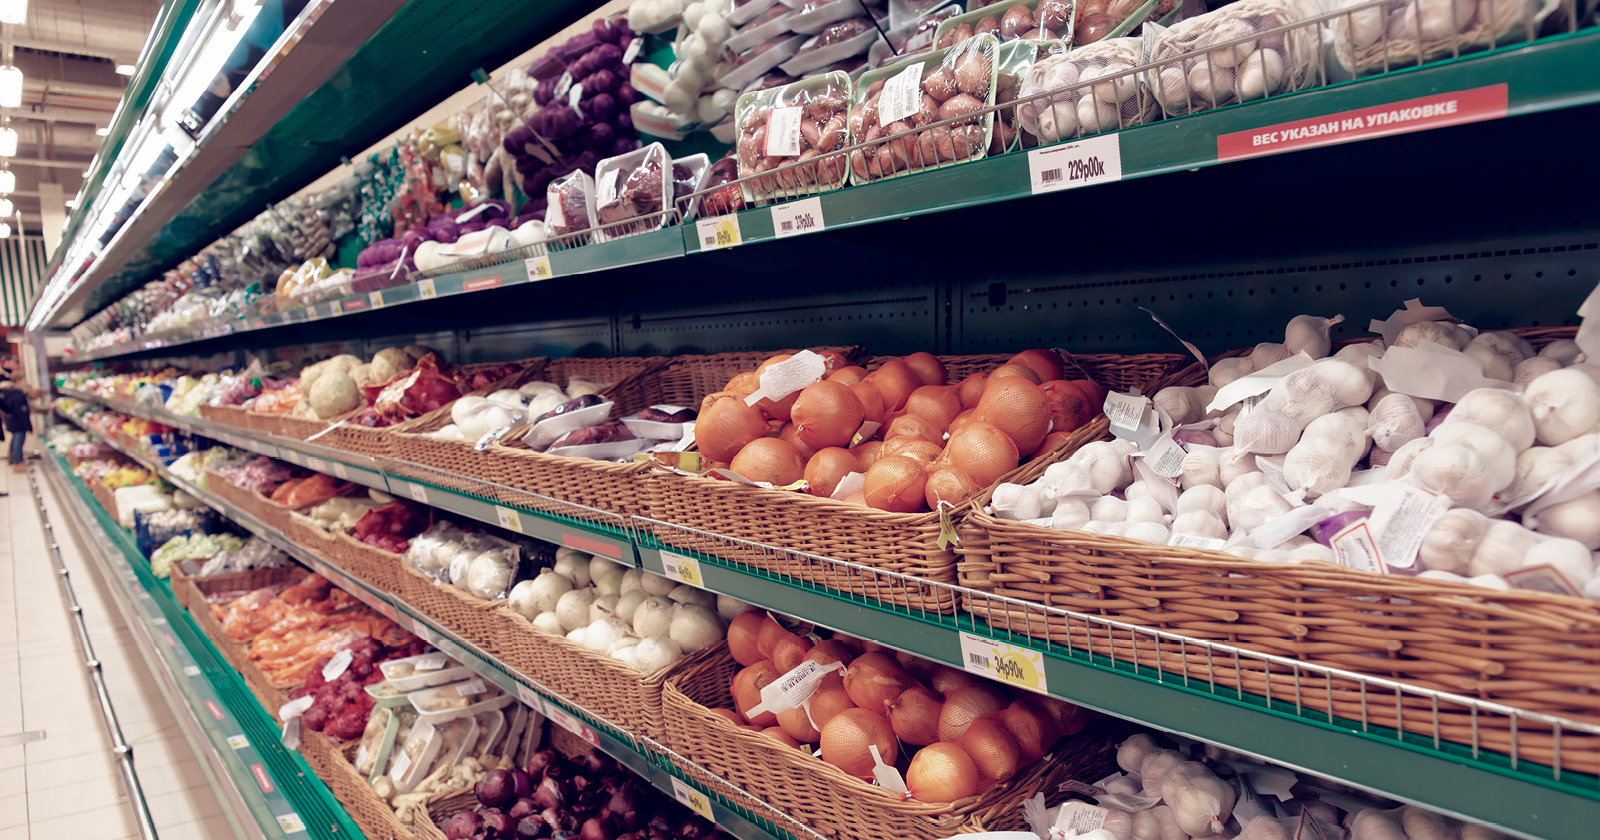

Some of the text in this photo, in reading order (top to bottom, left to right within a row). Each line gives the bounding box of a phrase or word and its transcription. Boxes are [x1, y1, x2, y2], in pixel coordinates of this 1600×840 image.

[1252, 100, 1458, 147] ВЕС УКАЗАН НА УПАКОВКЕ
[1068, 155, 1105, 182] 229р00к
[994, 655, 1025, 680] 34р90к
